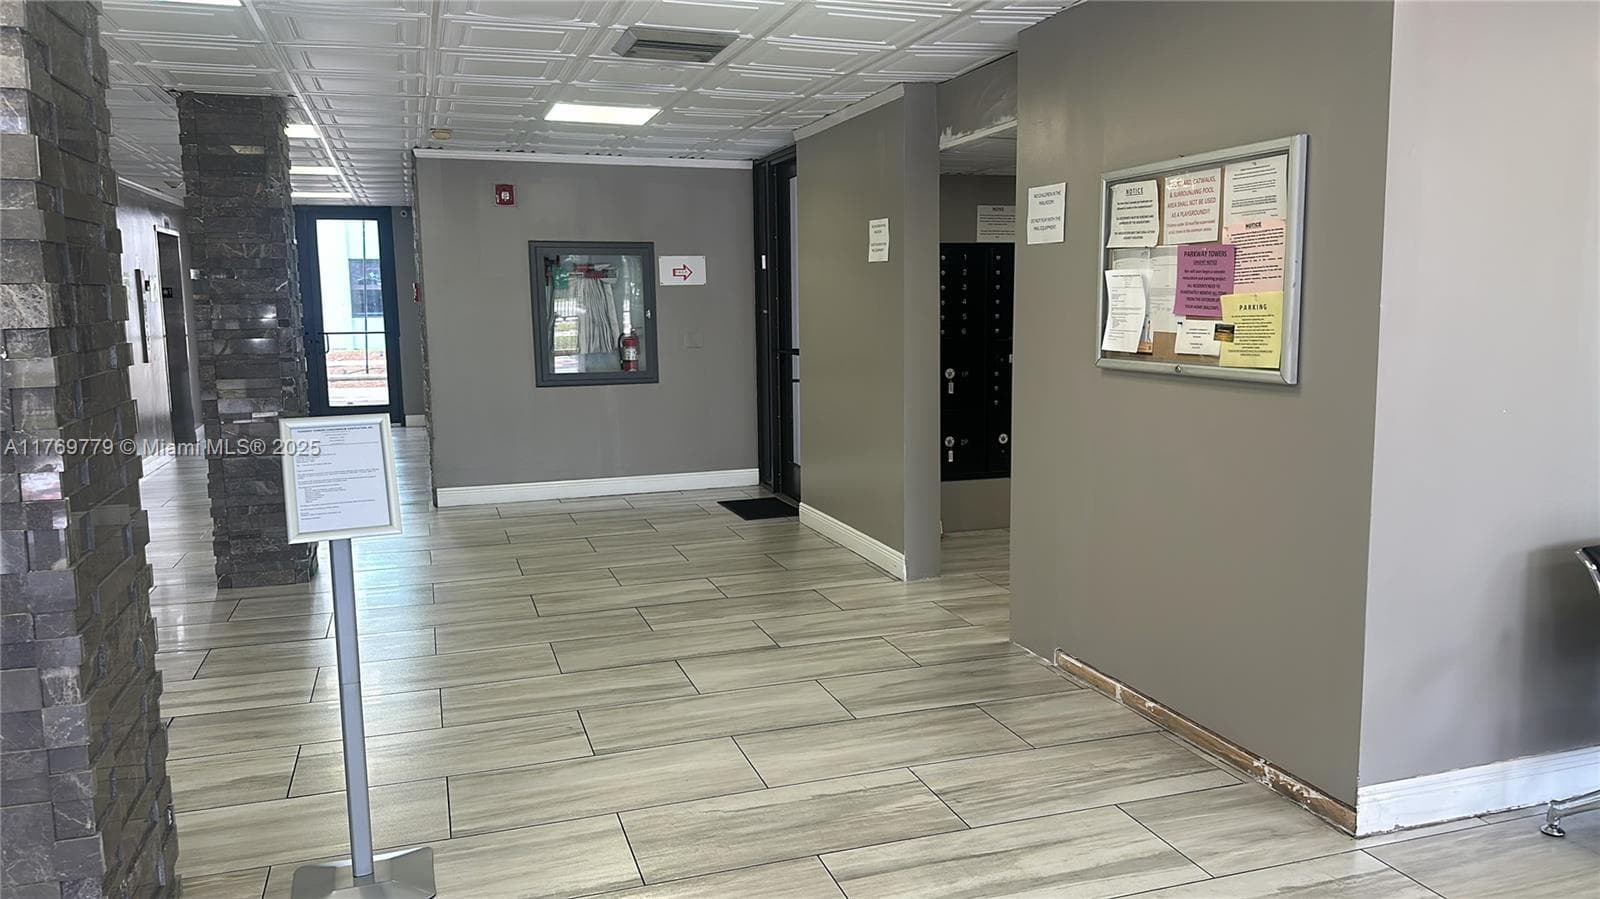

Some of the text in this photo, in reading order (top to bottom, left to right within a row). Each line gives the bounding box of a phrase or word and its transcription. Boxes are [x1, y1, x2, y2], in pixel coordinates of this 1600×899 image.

[1126, 187, 1144, 195] NOTICE
[1245, 221, 1262, 229] NOTICE
[961, 268, 967, 276] 2
[961, 283, 967, 291] 3
[1239, 303, 1267, 311] PARKING
[961, 312, 967, 320] 5
